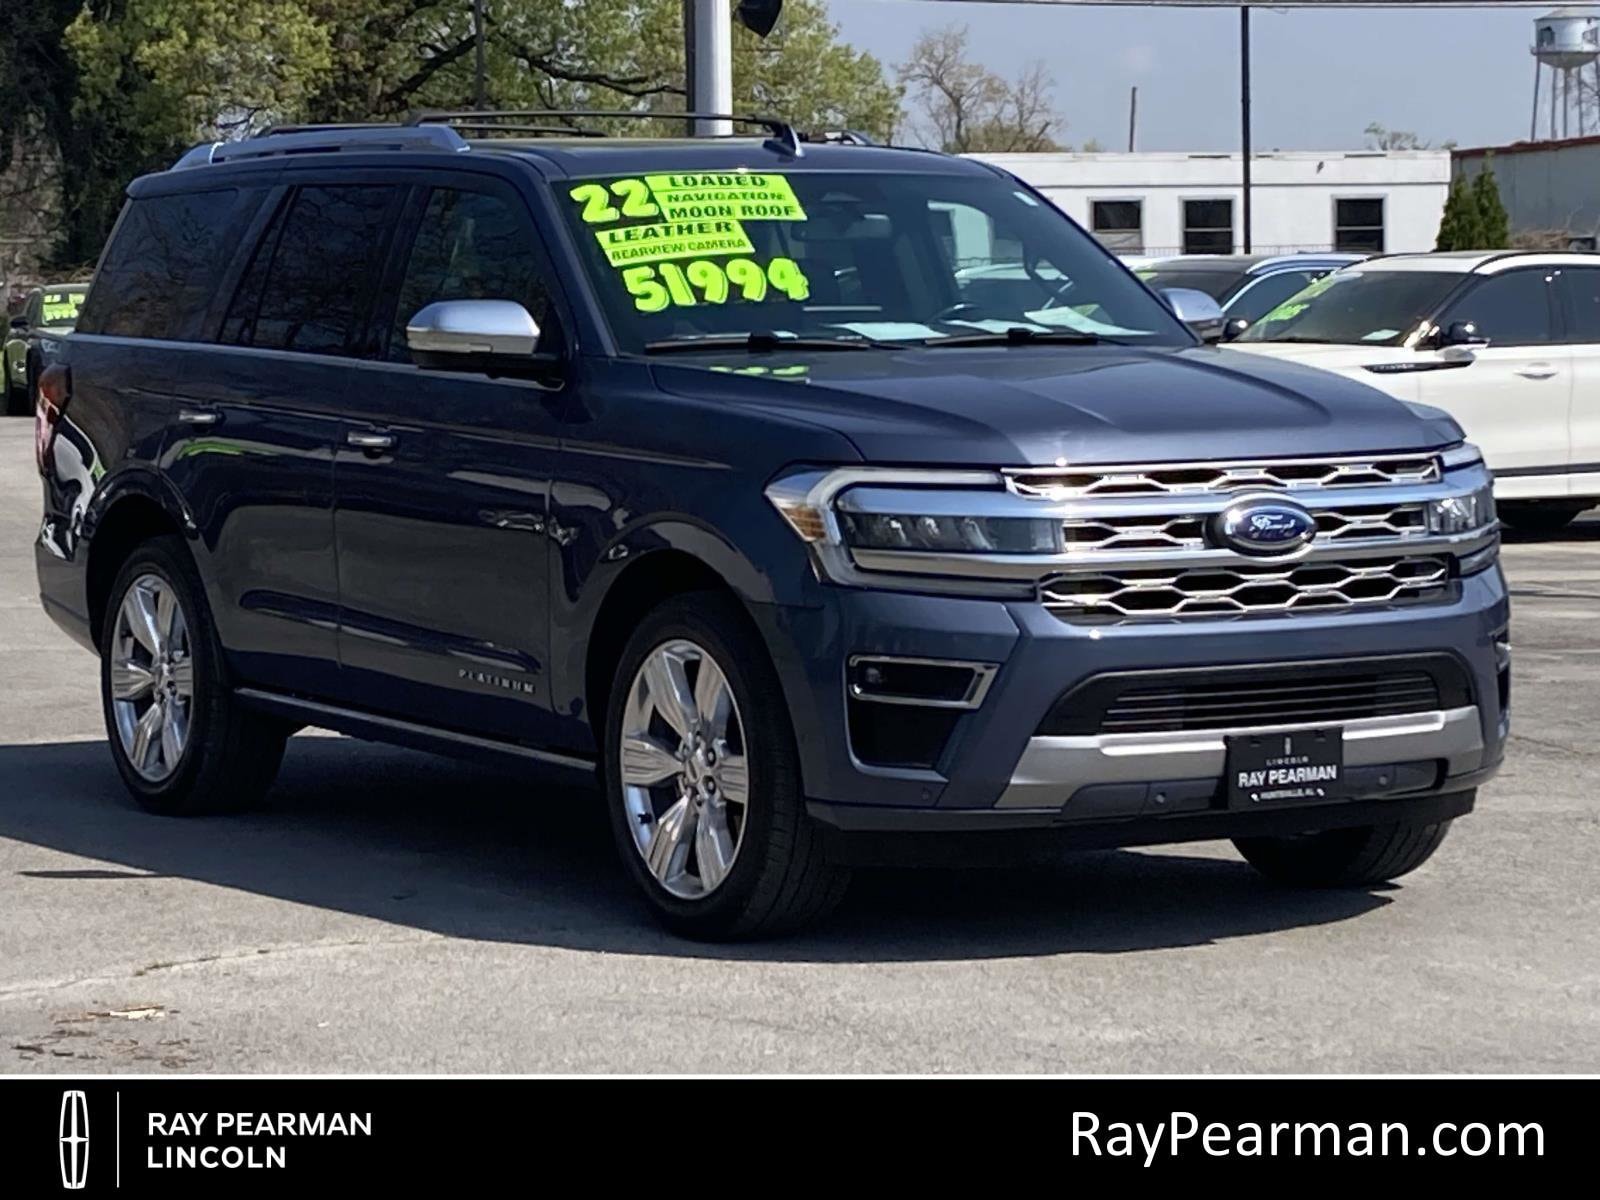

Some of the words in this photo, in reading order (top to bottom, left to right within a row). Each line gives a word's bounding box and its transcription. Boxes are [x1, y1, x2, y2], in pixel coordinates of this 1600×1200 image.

[669, 175, 767, 187] LOADED
[570, 179, 660, 222] 22
[667, 191, 786, 202] NAVIGATION
[669, 205, 733, 219] MOON
[740, 205, 796, 217] ROOF
[608, 220, 733, 244] LEATHER
[611, 243, 684, 261] REARVIEW
[687, 238, 747, 251] CAMERA
[622, 258, 810, 312] 51994
[1238, 770, 1266, 788] RAY
[1268, 765, 1337, 785] PEARMAN
